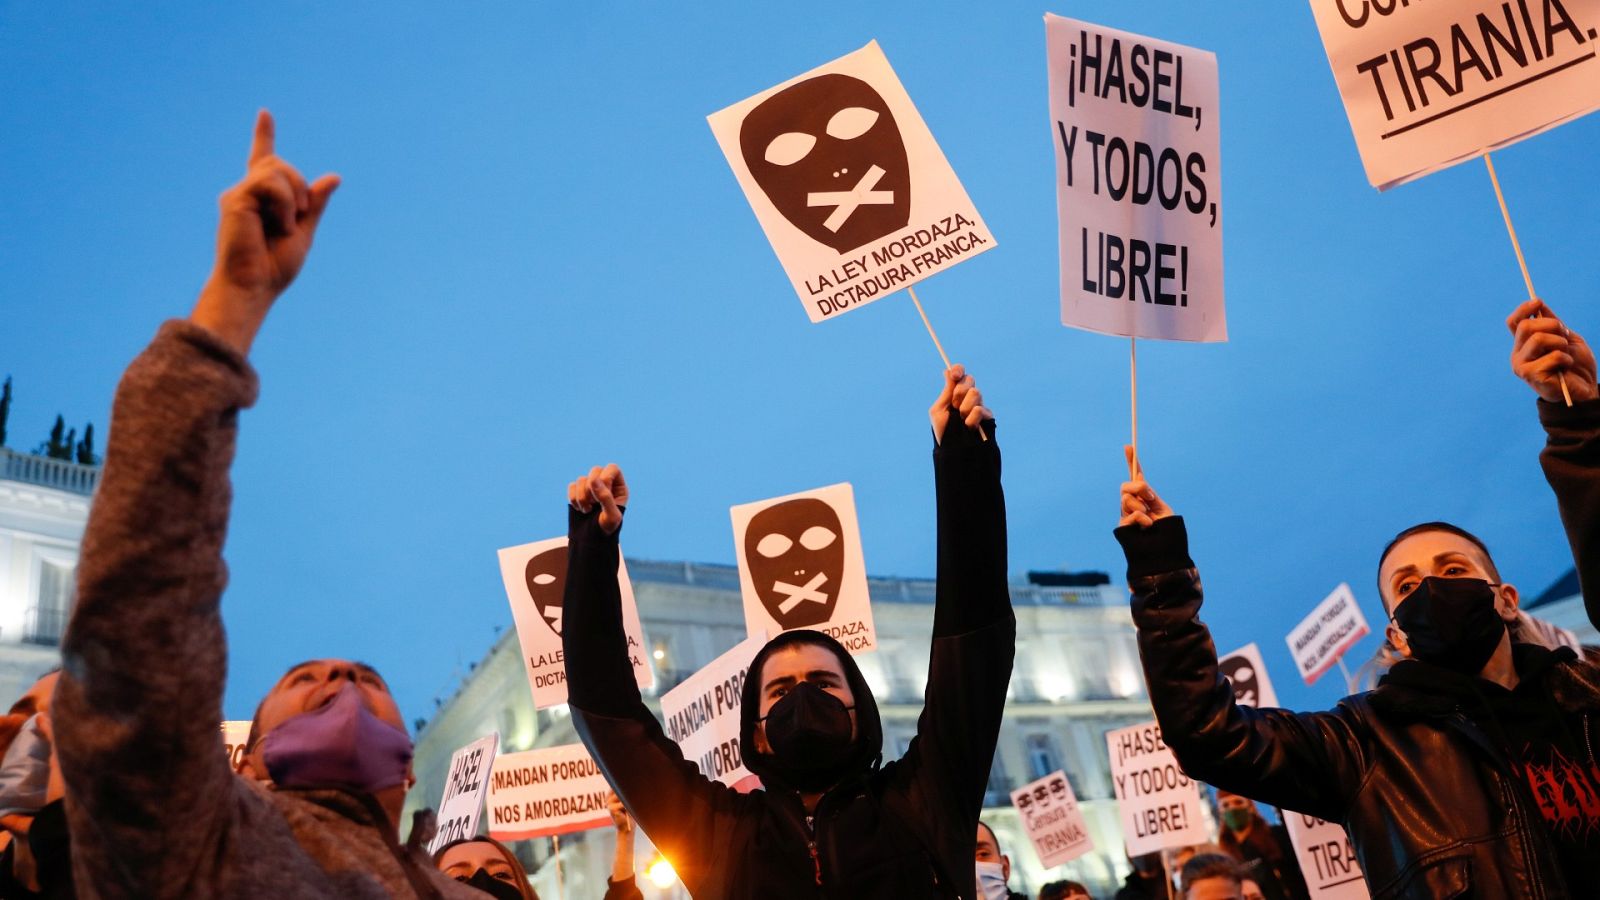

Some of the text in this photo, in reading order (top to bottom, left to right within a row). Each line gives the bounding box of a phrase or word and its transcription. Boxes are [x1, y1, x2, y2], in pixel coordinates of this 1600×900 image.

[1068, 30, 1201, 132] ¡HASEL,
[1057, 120, 1217, 228] Y TODOS,
[805, 213, 975, 295] LA LEY MORDAZA,
[1082, 227, 1188, 307] LIBRE!
[817, 231, 987, 316] DICTADURA FRANCA.
[822, 620, 869, 639] DAZA,
[843, 635, 872, 651] NCA.
[530, 650, 564, 669] LA LE
[535, 670, 567, 688] DICTA
[700, 738, 742, 781] AMORD
[1117, 727, 1165, 767] ¡HASE
[491, 765, 548, 795] ¡MANDAN
[1116, 774, 1126, 800] Y
[494, 791, 608, 824] NOS AMORDAZAN!
[1133, 803, 1188, 838] LIBRE!
[1307, 838, 1357, 880] TIRA
